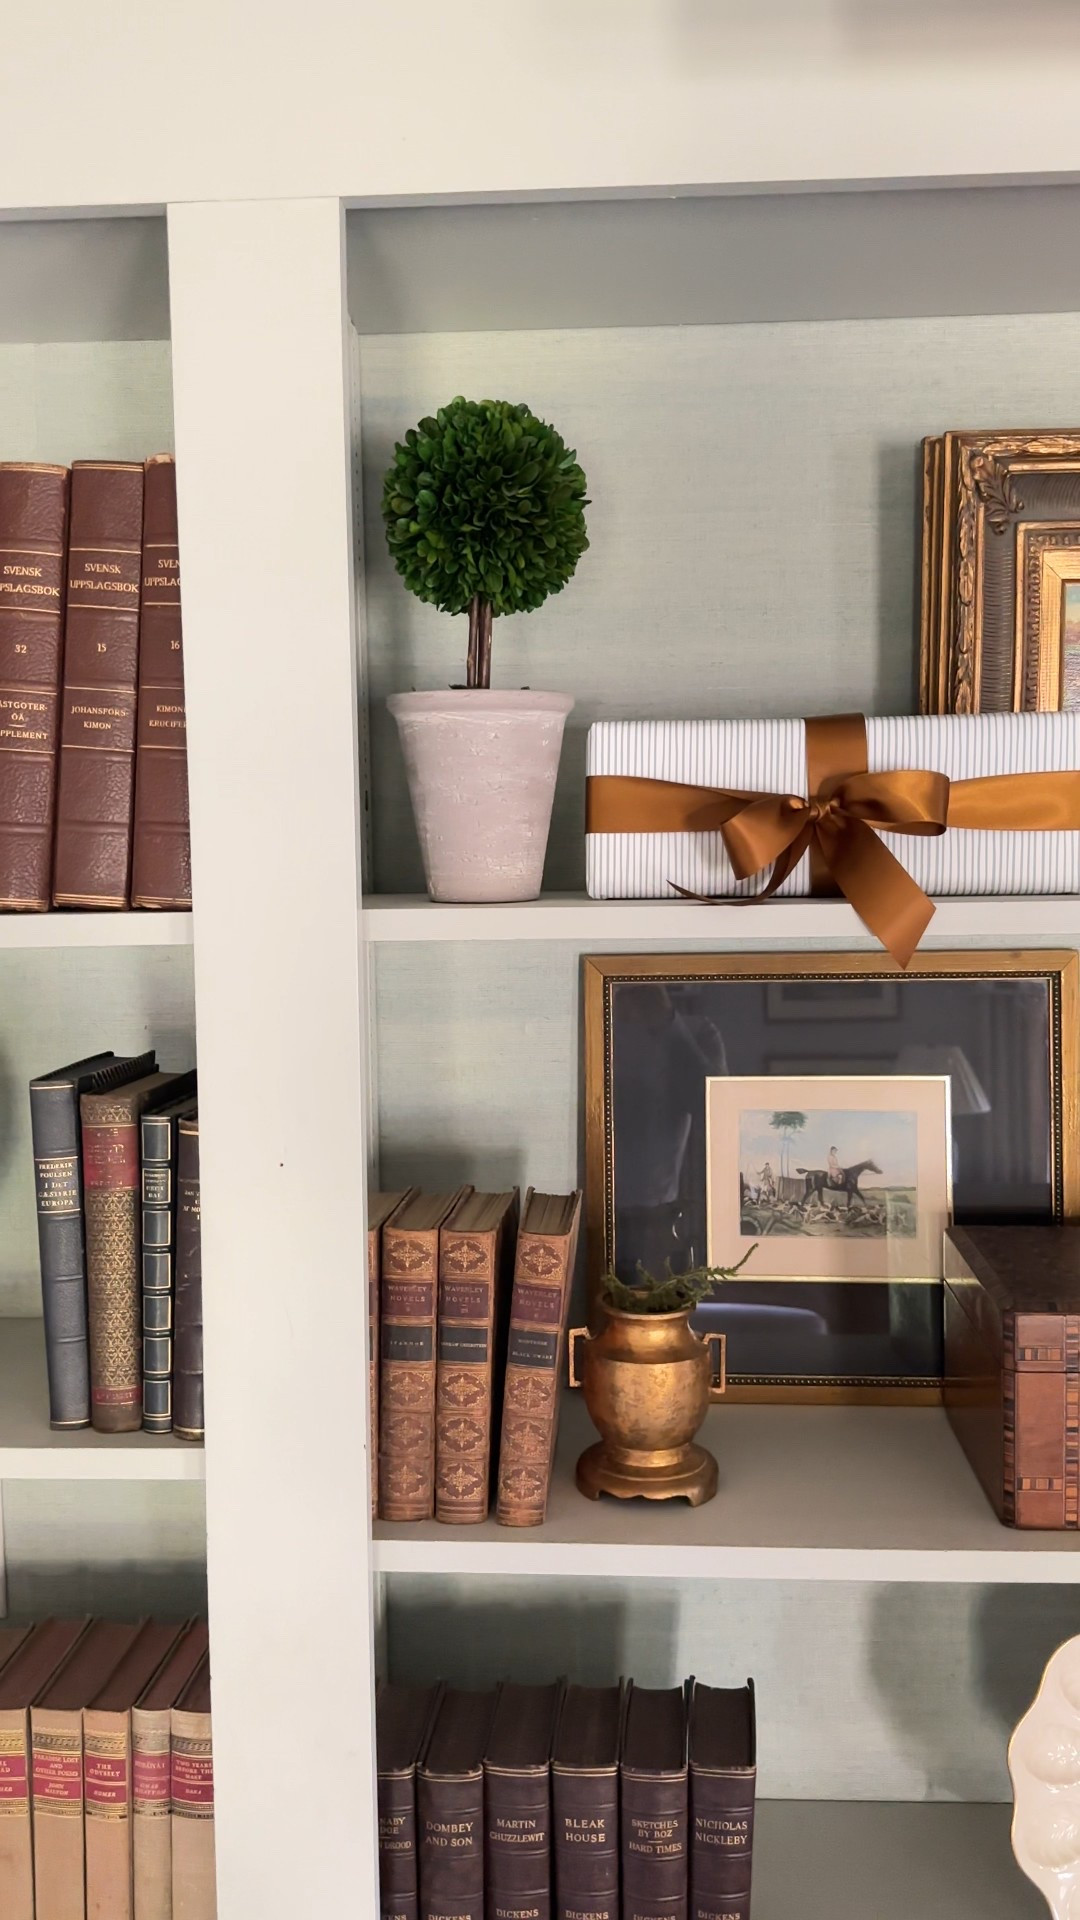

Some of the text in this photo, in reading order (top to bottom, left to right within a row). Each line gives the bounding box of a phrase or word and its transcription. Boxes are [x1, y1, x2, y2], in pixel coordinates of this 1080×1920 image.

[3, 565, 42, 577] SVENSK
[84, 563, 121, 574] SVENSK
[0, 582, 60, 597] PSLAGSBOK
[70, 579, 139, 593] UPPSLAGSBOK
[14, 644, 27, 654] 32
[97, 643, 107, 652] 15
[170, 640, 180, 650] 16
[71, 705, 129, 717] JOHANSFORS-
[83, 720, 112, 730] KIMON
[38, 1162, 73, 1170] FREDERIK
[41, 1199, 74, 1207] EUROPA
[444, 1285, 484, 1294] WAVERLEY
[390, 1295, 426, 1303] NOVELS
[445, 1296, 481, 1304] NOVELS
[425, 1820, 474, 1834] DOMBEY
[496, 1818, 536, 1829] MARTIN
[565, 1818, 605, 1829] BLEAK
[631, 1818, 679, 1830] SKETCHES
[695, 1817, 748, 1831] NICHOLAS
[565, 1832, 606, 1843] HOUSE
[638, 1829, 673, 1839] BY BOZ
[695, 1831, 748, 1846] NICKLEBY
[425, 1836, 473, 1848] AND SON
[629, 1841, 682, 1854] HARD TIMES
[496, 1908, 539, 1919] DICKENS
[565, 1910, 609, 1920] DICKENS
[697, 1910, 741, 1920] DICKENS
